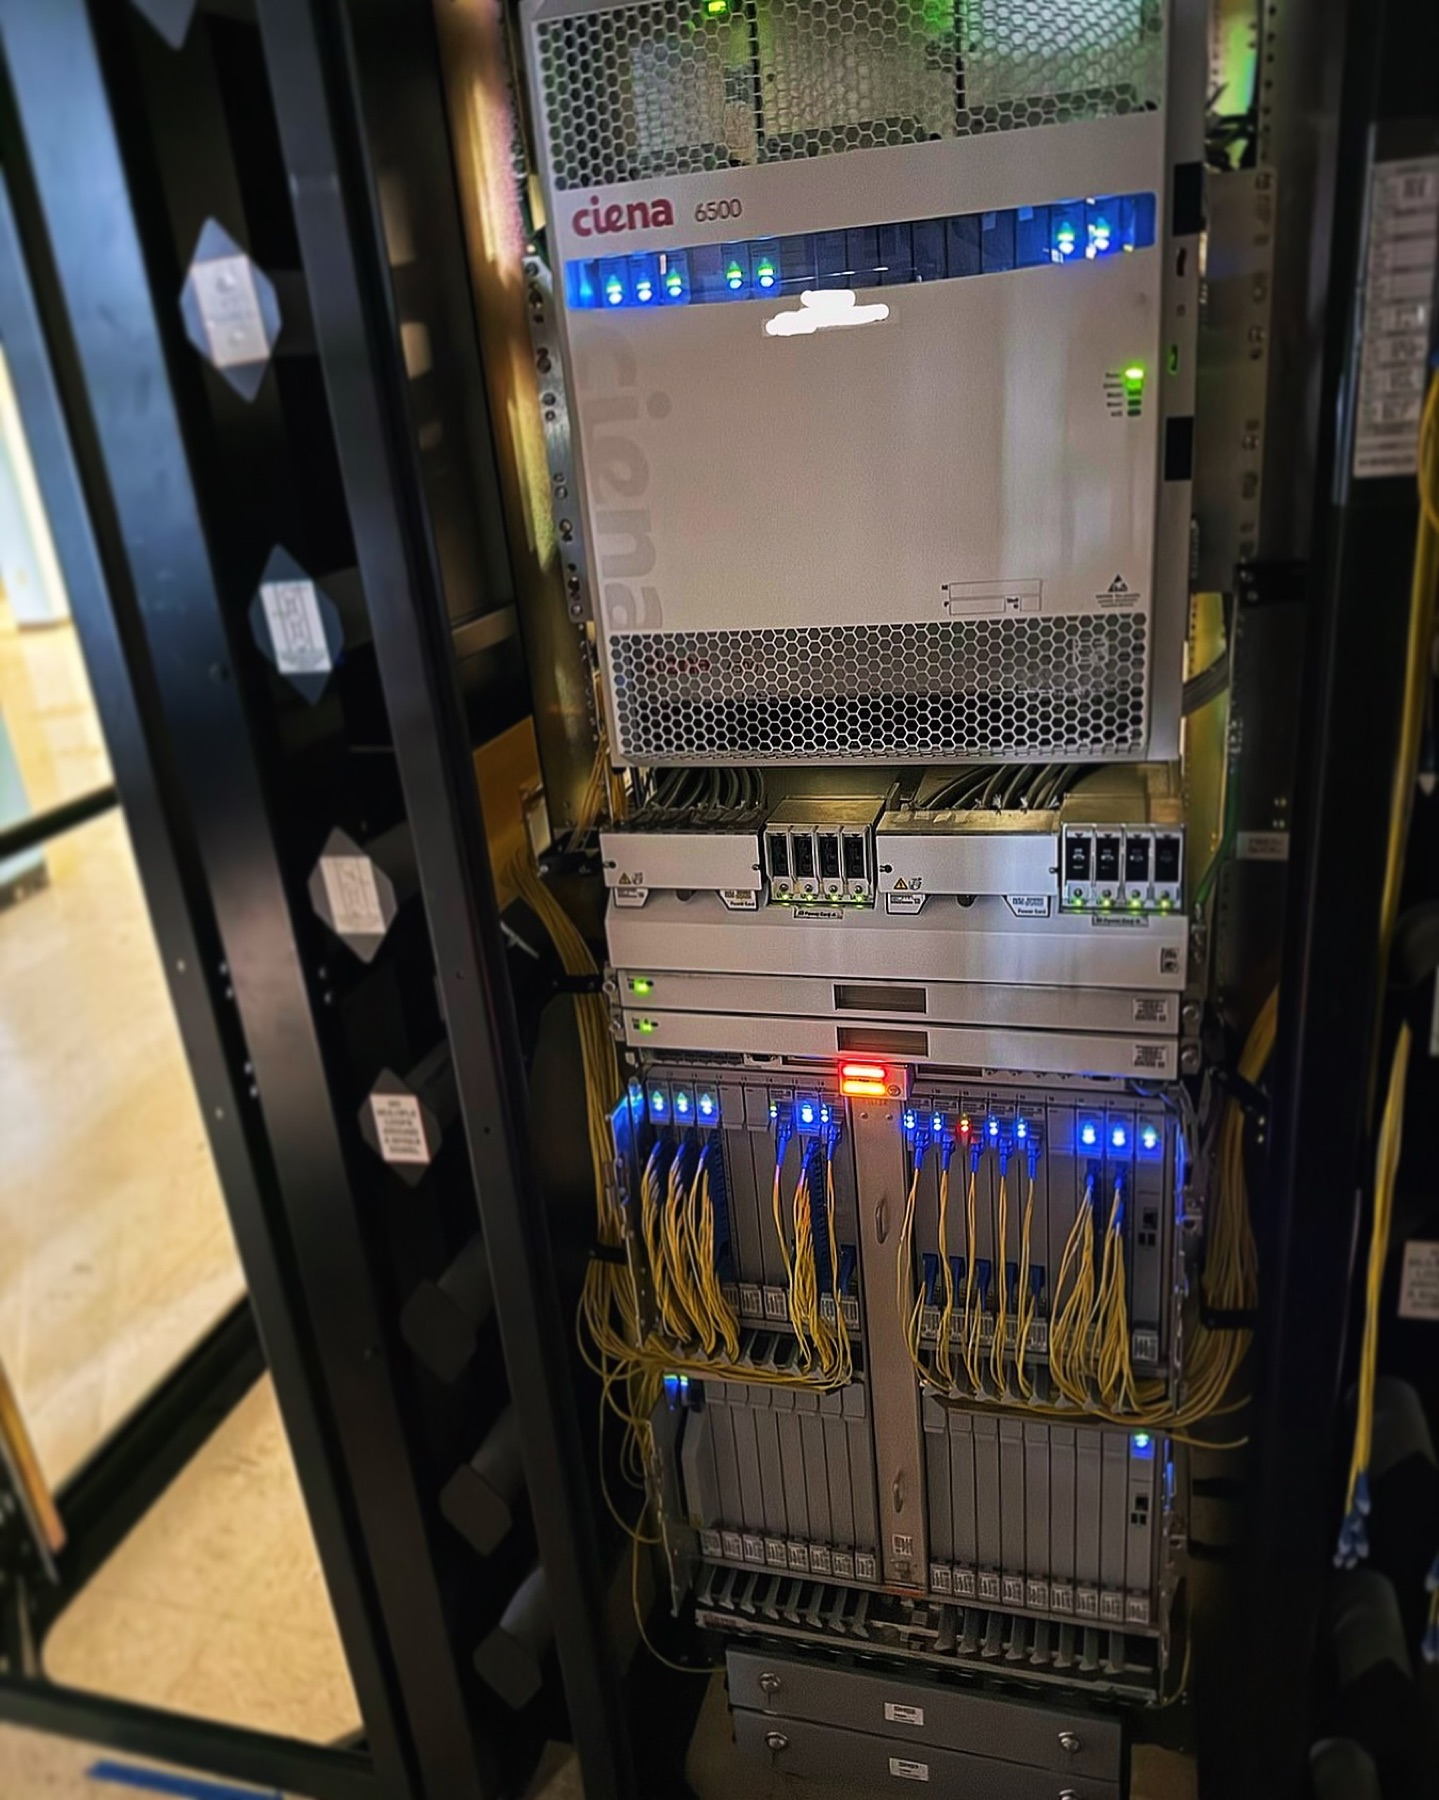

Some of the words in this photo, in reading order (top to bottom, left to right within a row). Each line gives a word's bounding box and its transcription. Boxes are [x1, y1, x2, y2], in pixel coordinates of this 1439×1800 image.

[571, 194, 675, 238] ciena
[693, 198, 744, 223] 6500
[573, 326, 673, 630] ciena
